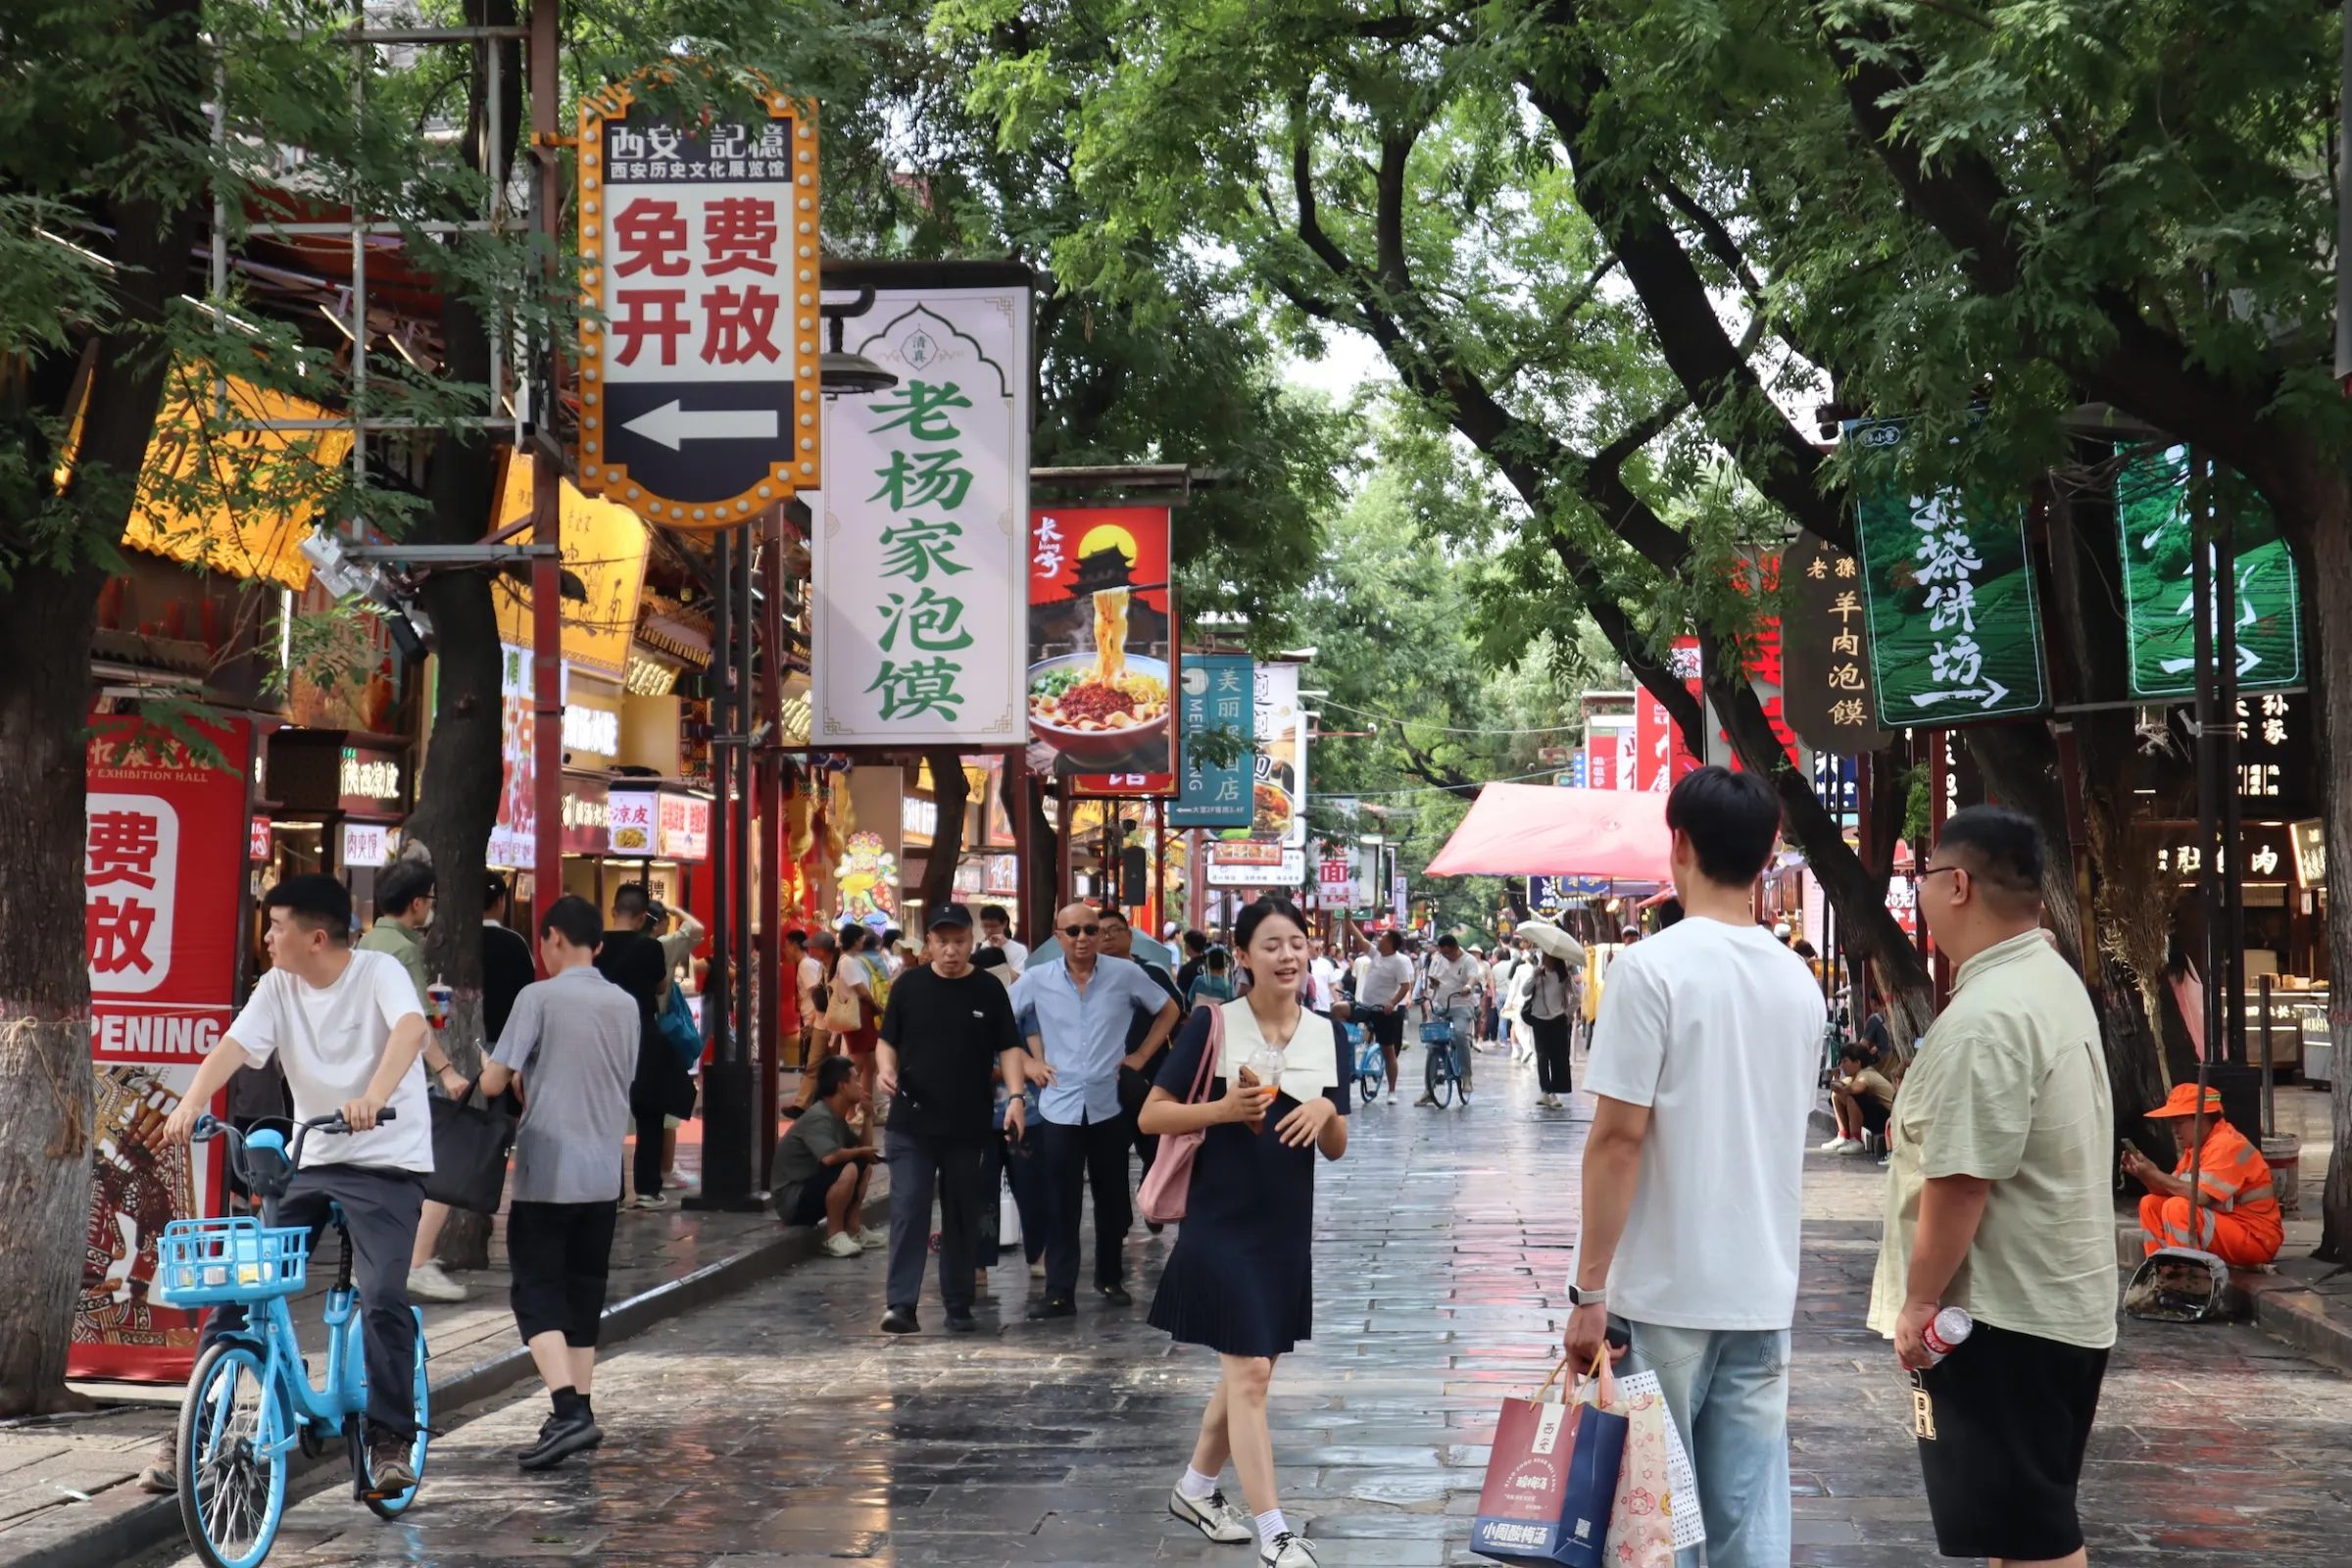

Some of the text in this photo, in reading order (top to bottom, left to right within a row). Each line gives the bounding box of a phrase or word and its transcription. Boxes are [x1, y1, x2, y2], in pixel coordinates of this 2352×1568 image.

[610, 125, 681, 159] 西安
[610, 160, 785, 179] 西安历史文化展览馆
[612, 197, 779, 278] 免费
[612, 285, 781, 367] 开放
[911, 335, 927, 364] 清真
[863, 378, 974, 722] 老杨家泡馍
[1189, 699, 1202, 791] MEILENG
[1215, 667, 1242, 801] 美丽酒店
[98, 768, 172, 781] EXHIBITION
[175, 771, 209, 782] HALL
[85, 810, 159, 890] 费
[86, 896, 157, 975] 放
[1539, 1422, 1555, 1451] 西安
[1911, 1387, 1936, 1441] R
[1482, 1521, 1548, 1545] 小周酸梅汤
